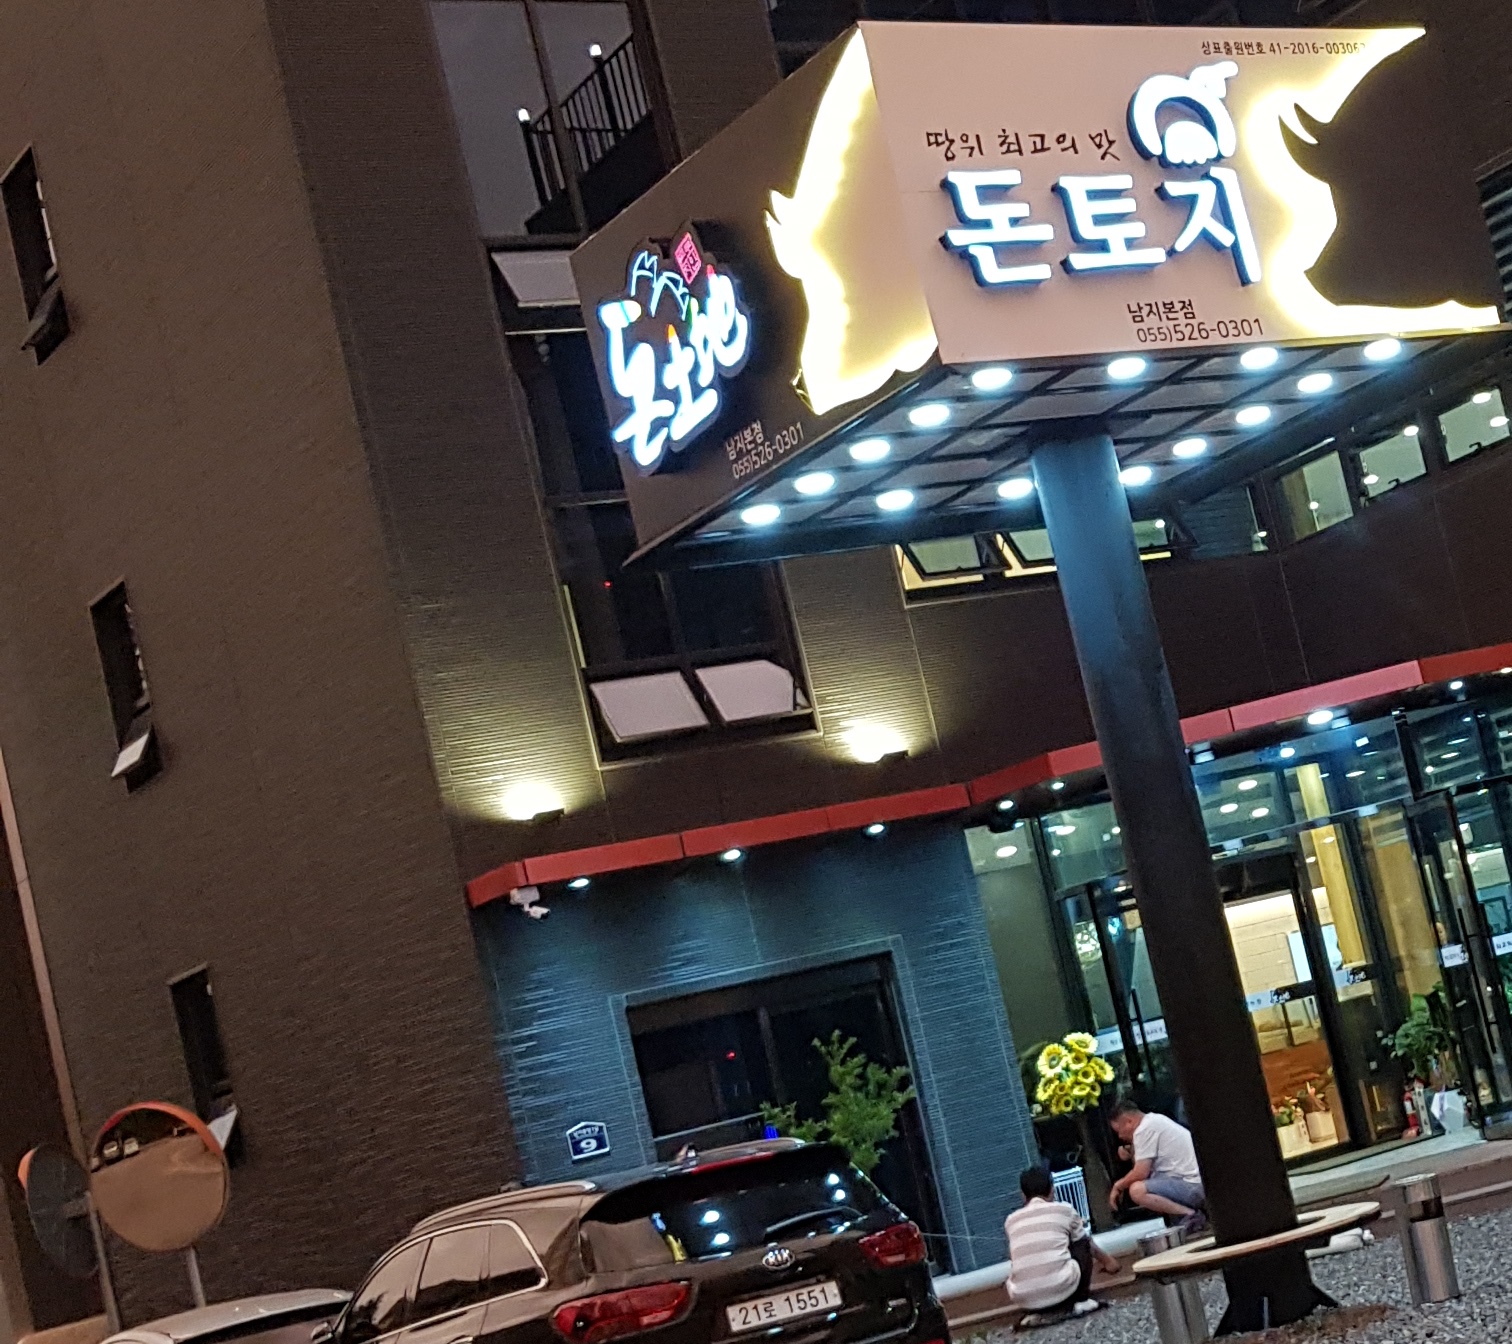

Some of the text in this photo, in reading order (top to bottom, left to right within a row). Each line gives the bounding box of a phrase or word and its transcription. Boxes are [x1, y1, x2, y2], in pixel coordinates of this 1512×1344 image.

[925, 127, 1121, 162] 땅위 최고의 맛
[939, 166, 1263, 288] 돈토지
[1126, 298, 1197, 324] 남지본점
[1136, 317, 1264, 343] 055)526-0301
[725, 419, 764, 461] 남지본점
[732, 421, 804, 480] 055)526-0301
[579, 1138, 598, 1153] 9
[738, 1286, 830, 1326] 21로 1551
